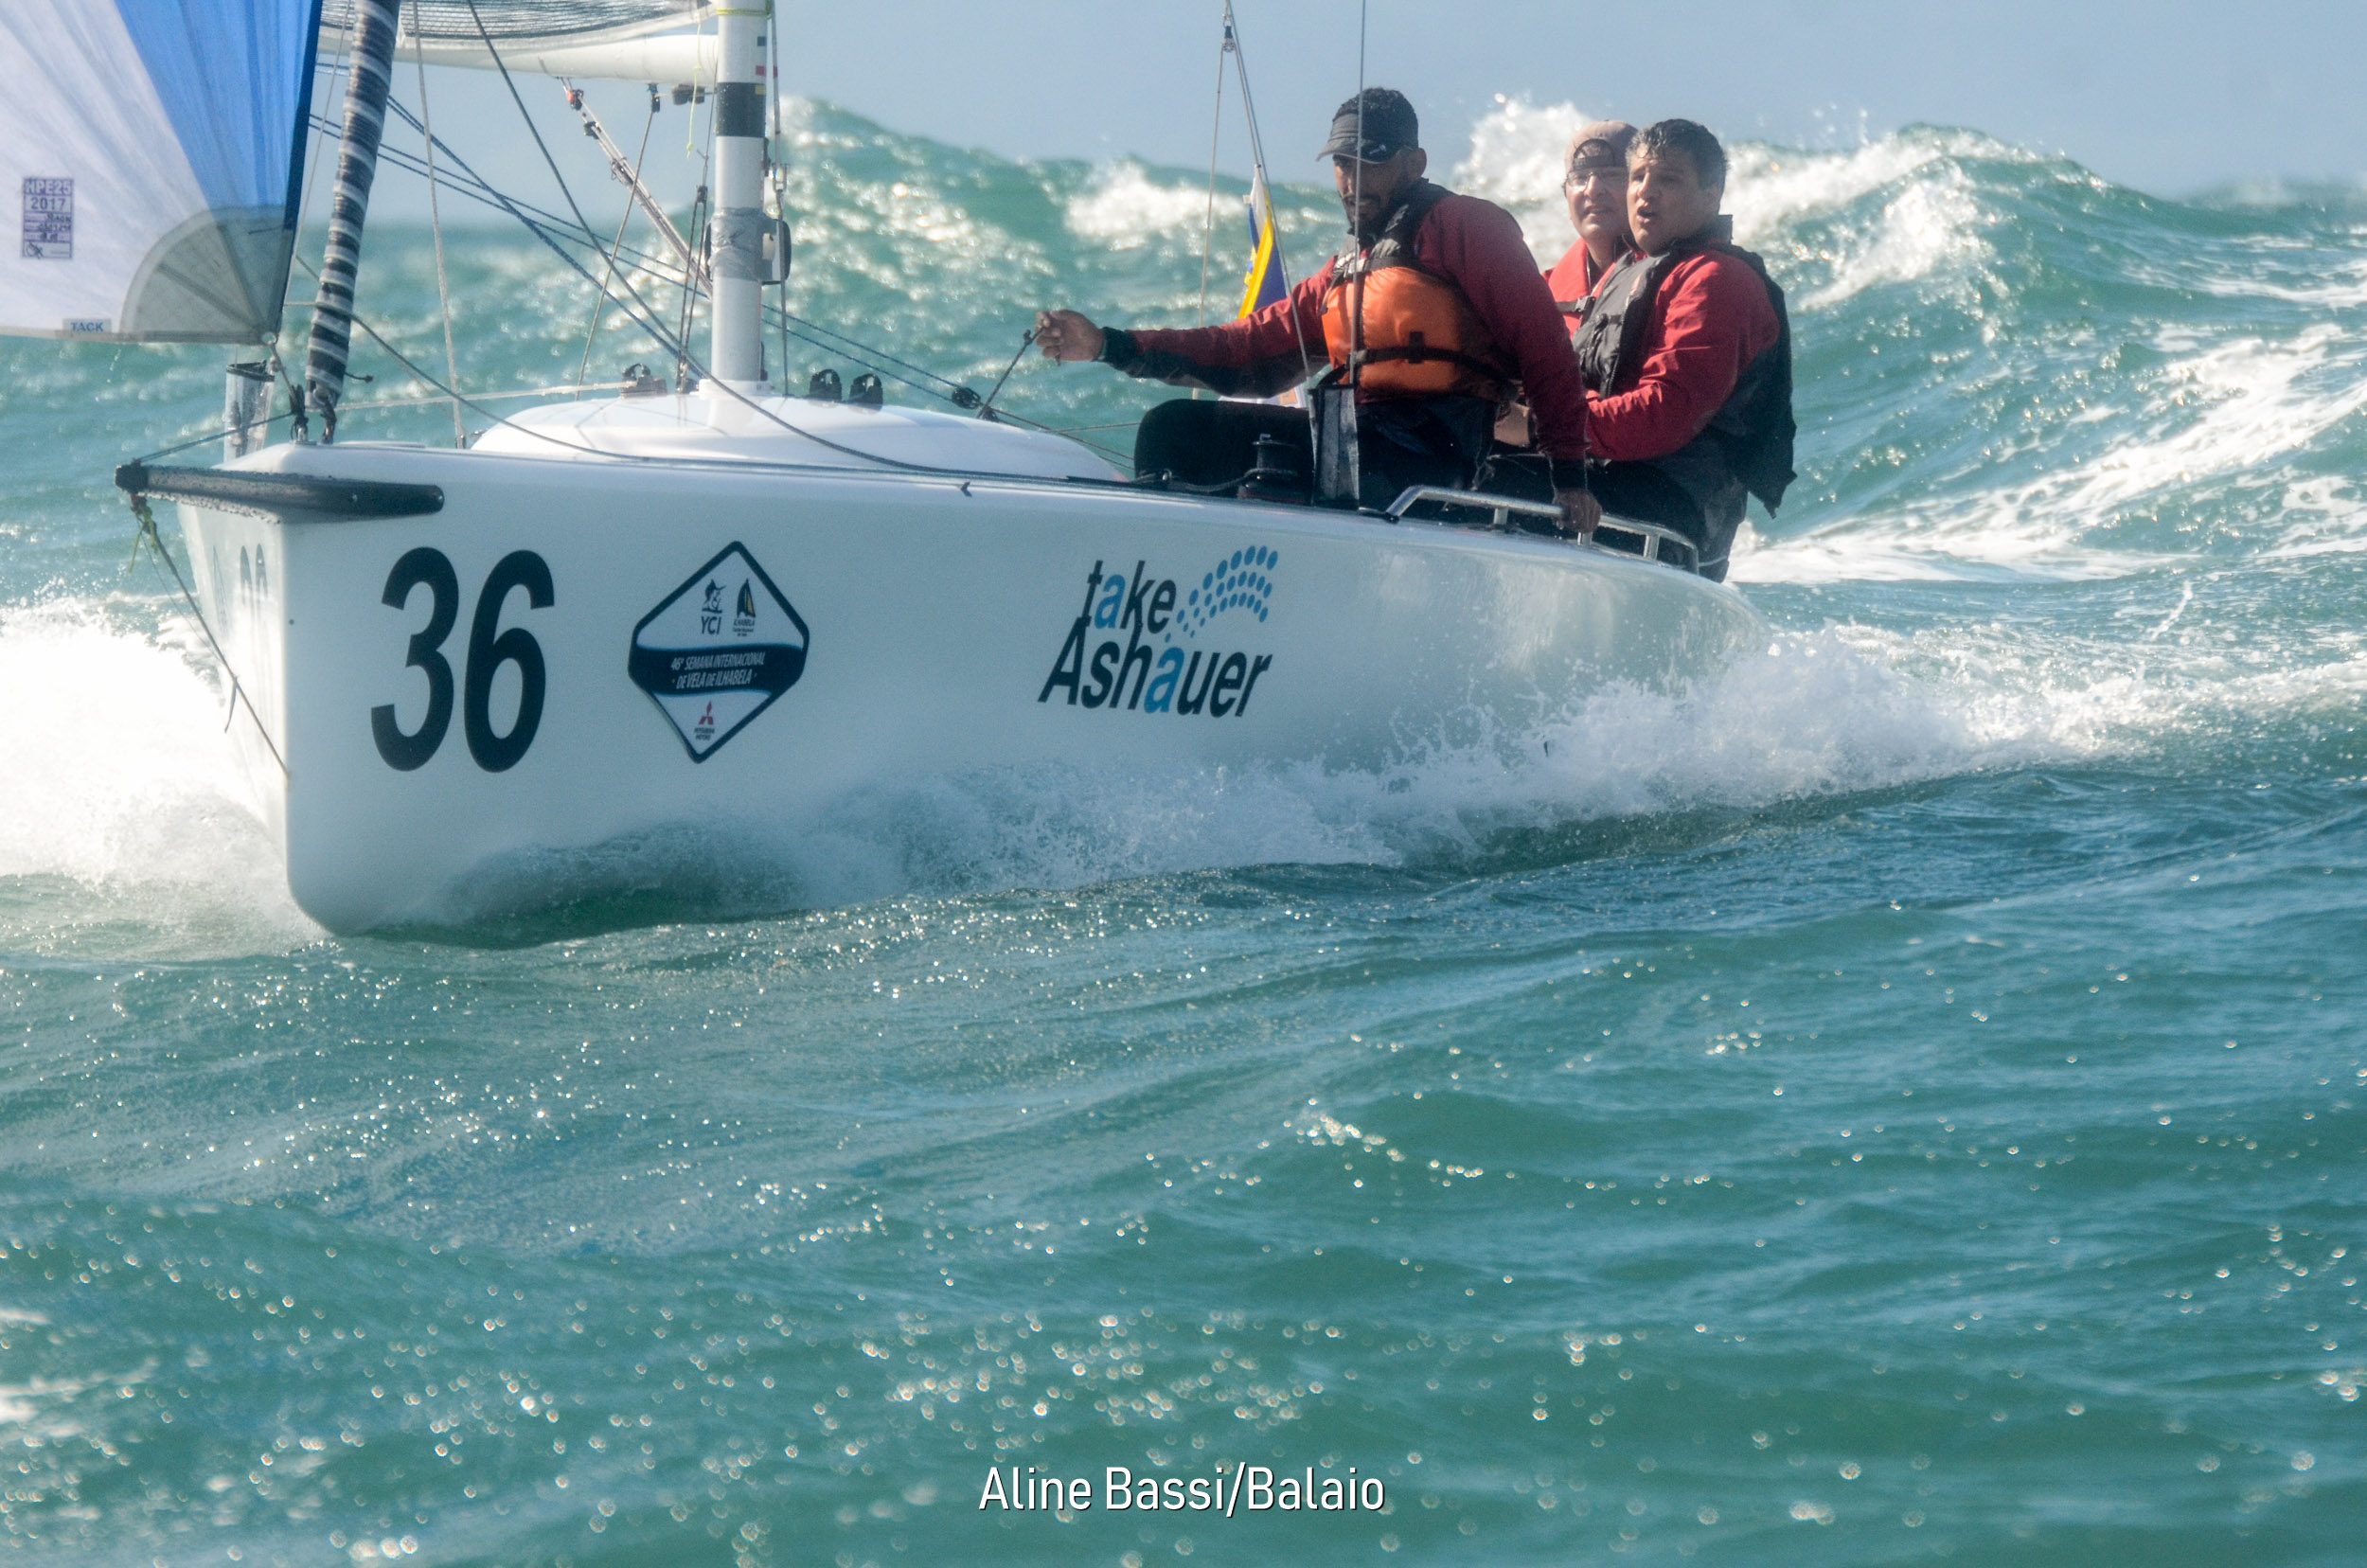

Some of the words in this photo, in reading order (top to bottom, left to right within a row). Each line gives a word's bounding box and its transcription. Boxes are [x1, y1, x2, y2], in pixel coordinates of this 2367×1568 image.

[30, 197, 66, 210] 2017
[70, 322, 103, 332] TACK
[1081, 560, 1177, 634] take
[701, 616, 722, 635] YCI
[370, 546, 555, 773] 36
[684, 654, 714, 670] SEMANA
[713, 651, 766, 668] INTERNACIONAL
[1037, 615, 1273, 719] Ashauer
[676, 674, 687, 689] DE
[686, 671, 706, 688] VELA
[704, 672, 717, 687] DE
[714, 668, 753, 686] ILHABELA
